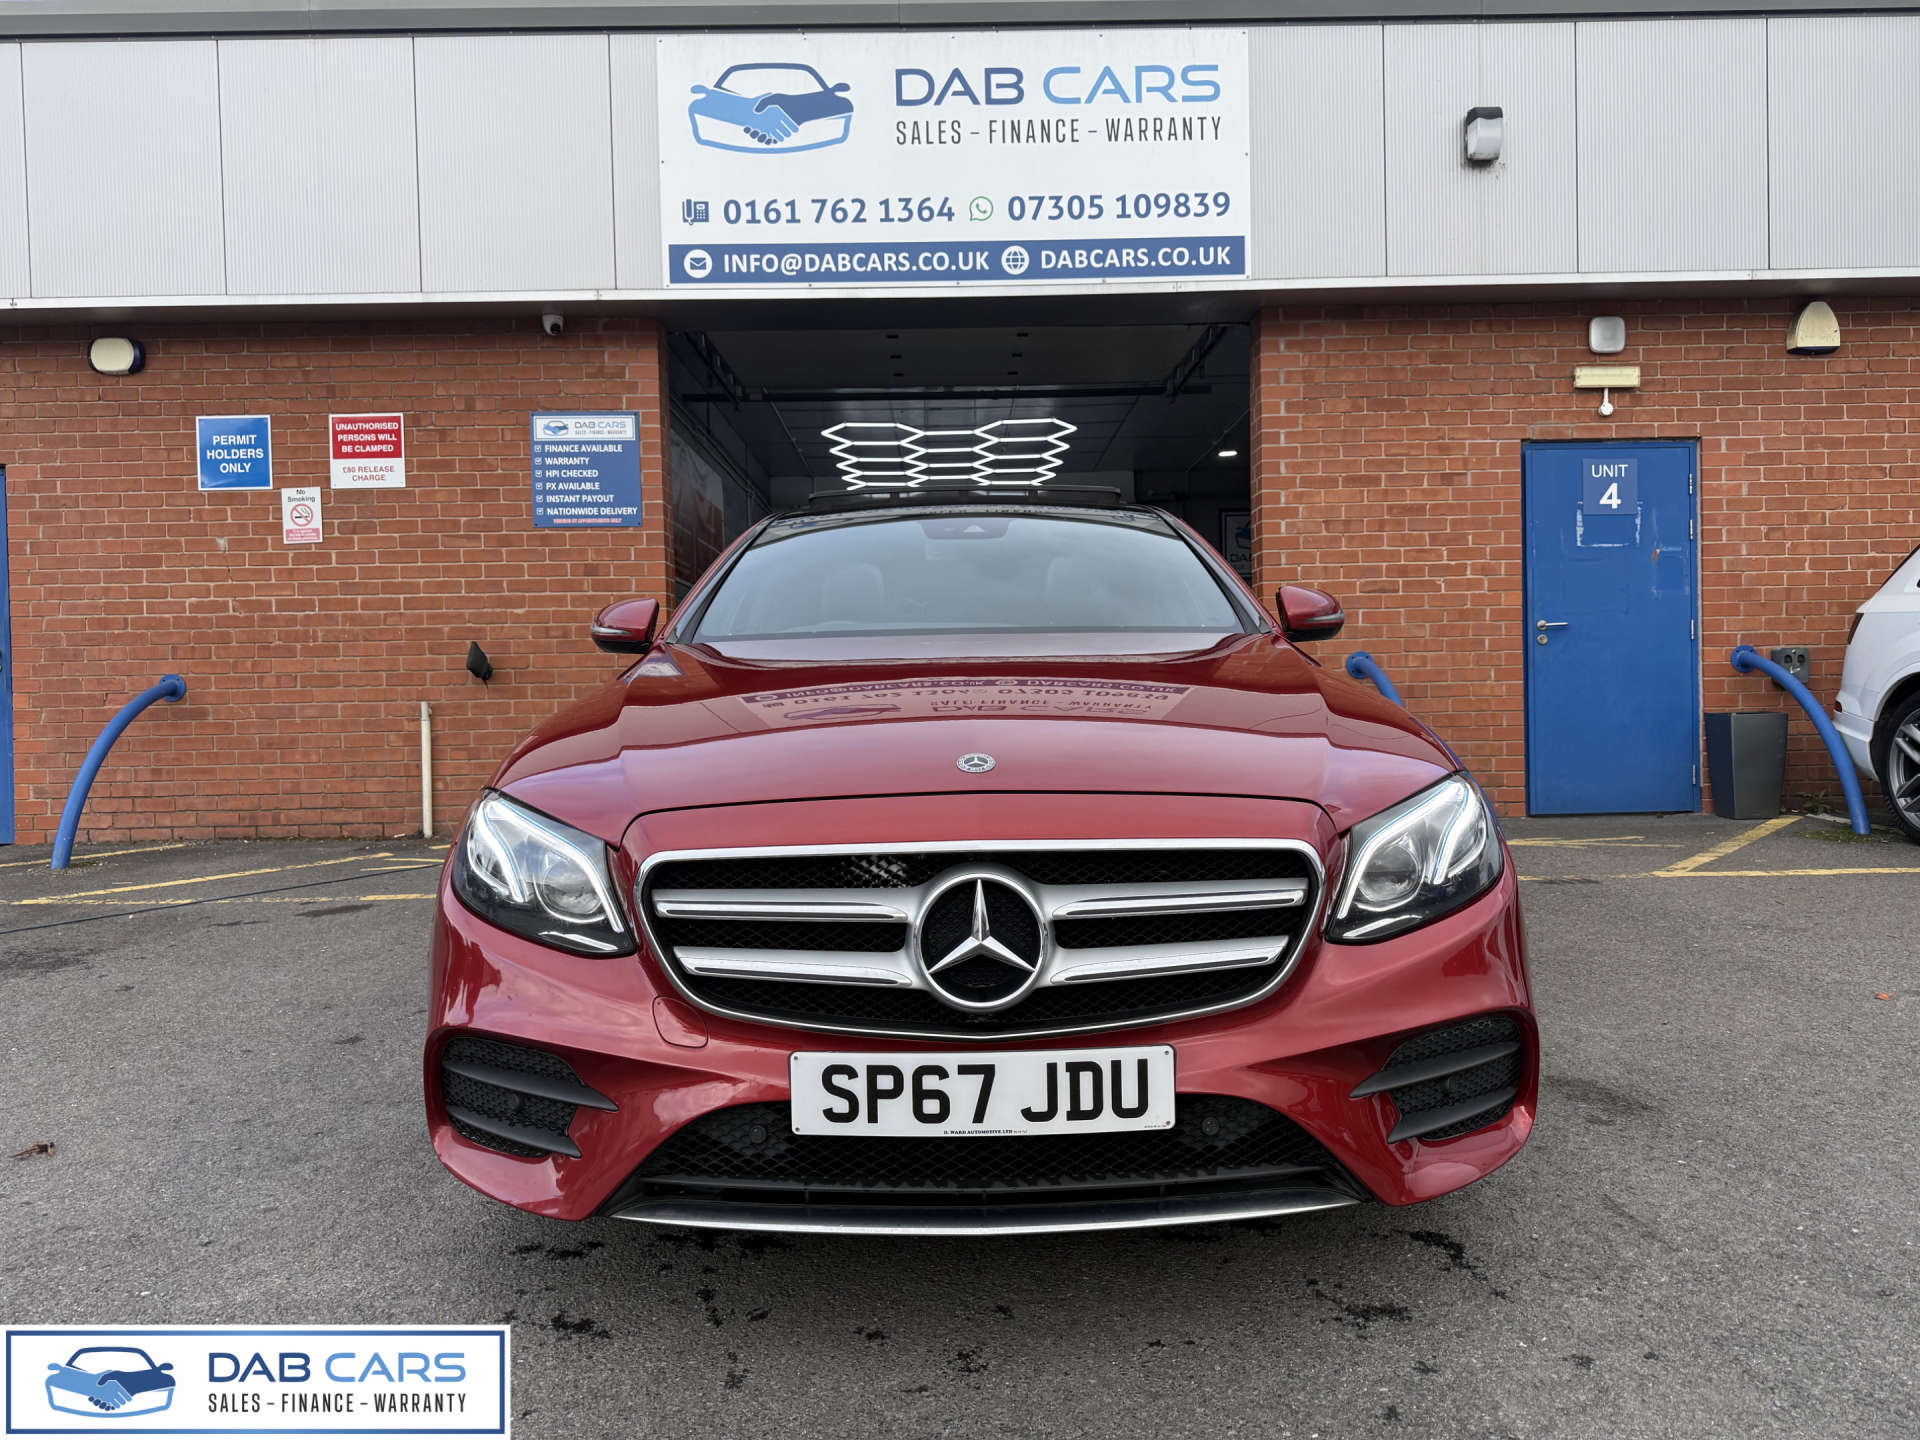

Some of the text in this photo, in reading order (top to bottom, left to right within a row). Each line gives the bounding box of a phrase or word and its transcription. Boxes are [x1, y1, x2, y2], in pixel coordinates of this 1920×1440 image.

[896, 65, 1220, 106] DAB CARS
[897, 120, 960, 145] SALES
[989, 119, 1079, 144] FINANCE
[1105, 117, 1220, 142] WARRANTY
[724, 192, 1230, 224] 0161 762 1364 07305 109839
[724, 247, 1230, 275] INFO@DABCARS.CO.UK DABCARS.CO.UK
[336, 422, 398, 430] UNAUTHORISED
[212, 434, 256, 446] PERMIT
[338, 434, 376, 442] PERSONS
[342, 444, 394, 452] BE CLAMPED
[544, 444, 622, 452] FINANCE AVAILABLE
[206, 448, 264, 460] HOLDERS
[544, 456, 590, 466] WARRANTY
[220, 462, 252, 474] ONLY
[1592, 464, 1628, 478] UNIT
[352, 474, 386, 482] CHARGE
[546, 470, 598, 478] HPI CHECKED
[546, 482, 600, 490] PX AVAILABLE
[546, 494, 614, 502] INSTANT PAYOUT
[1600, 483, 1621, 508] 4
[546, 506, 638, 516] NATIONWIDE DELIVERY
[822, 1059, 1148, 1124] SP67 JDU
